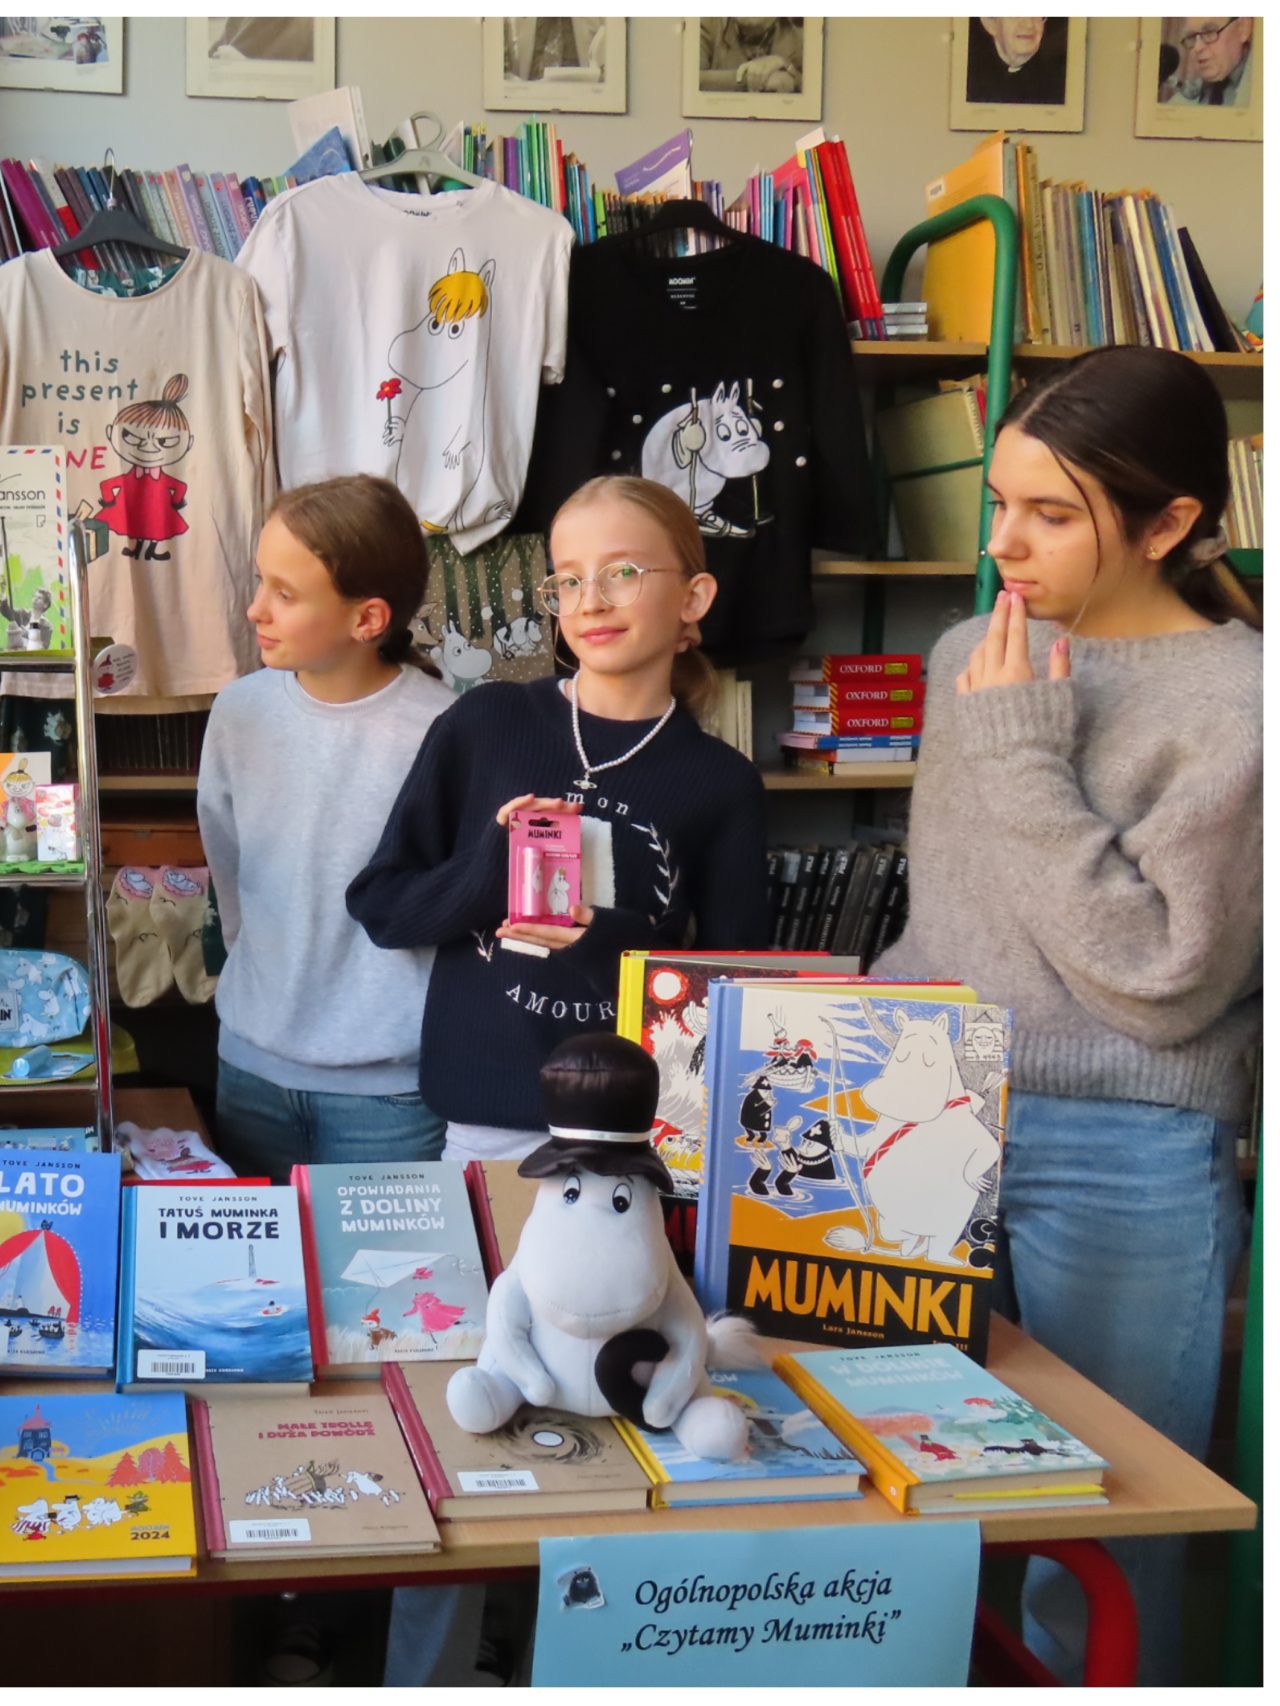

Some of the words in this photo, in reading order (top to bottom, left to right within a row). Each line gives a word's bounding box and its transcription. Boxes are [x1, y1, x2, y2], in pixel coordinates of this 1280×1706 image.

[60, 350, 119, 374] this
[22, 378, 138, 408] present
[58, 412, 80, 435] is
[66, 446, 108, 470] NE
[840, 664, 882, 674] OXFORD
[846, 691, 888, 700] OXFORD
[847, 718, 889, 728] OXFORD
[566, 791, 630, 815] mon
[528, 829, 562, 840] MUMINKI
[506, 984, 616, 1022] AMOUR
[3, 1159, 28, 1167] TOVE
[35, 1161, 81, 1169] JANSSON
[337, 1184, 441, 1196] OPOWIADANIA
[158, 1205, 204, 1218] TATUŚ
[210, 1207, 278, 1218] MUMINKA
[340, 1200, 353, 1216] Z
[361, 1197, 442, 1214] DOLINY
[159, 1221, 168, 1239] I
[177, 1221, 280, 1240] MORZE
[341, 1213, 446, 1233] MUMINKÓW
[744, 1256, 973, 1338] MUMINKI
[823, 1324, 843, 1332] Lars
[847, 1326, 885, 1339] Jansson
[830, 1363, 851, 1376] W
[267, 1429, 307, 1439] DUŻA
[278, 1422, 317, 1430] MAŁE
[321, 1421, 374, 1430] TROLLE
[131, 1531, 170, 1541] 2024
[635, 1572, 815, 1614] Ogólnopolska
[823, 1569, 892, 1606] akcja
[621, 1624, 755, 1655] „Czytamy
[761, 1609, 903, 1644] Muminki”
